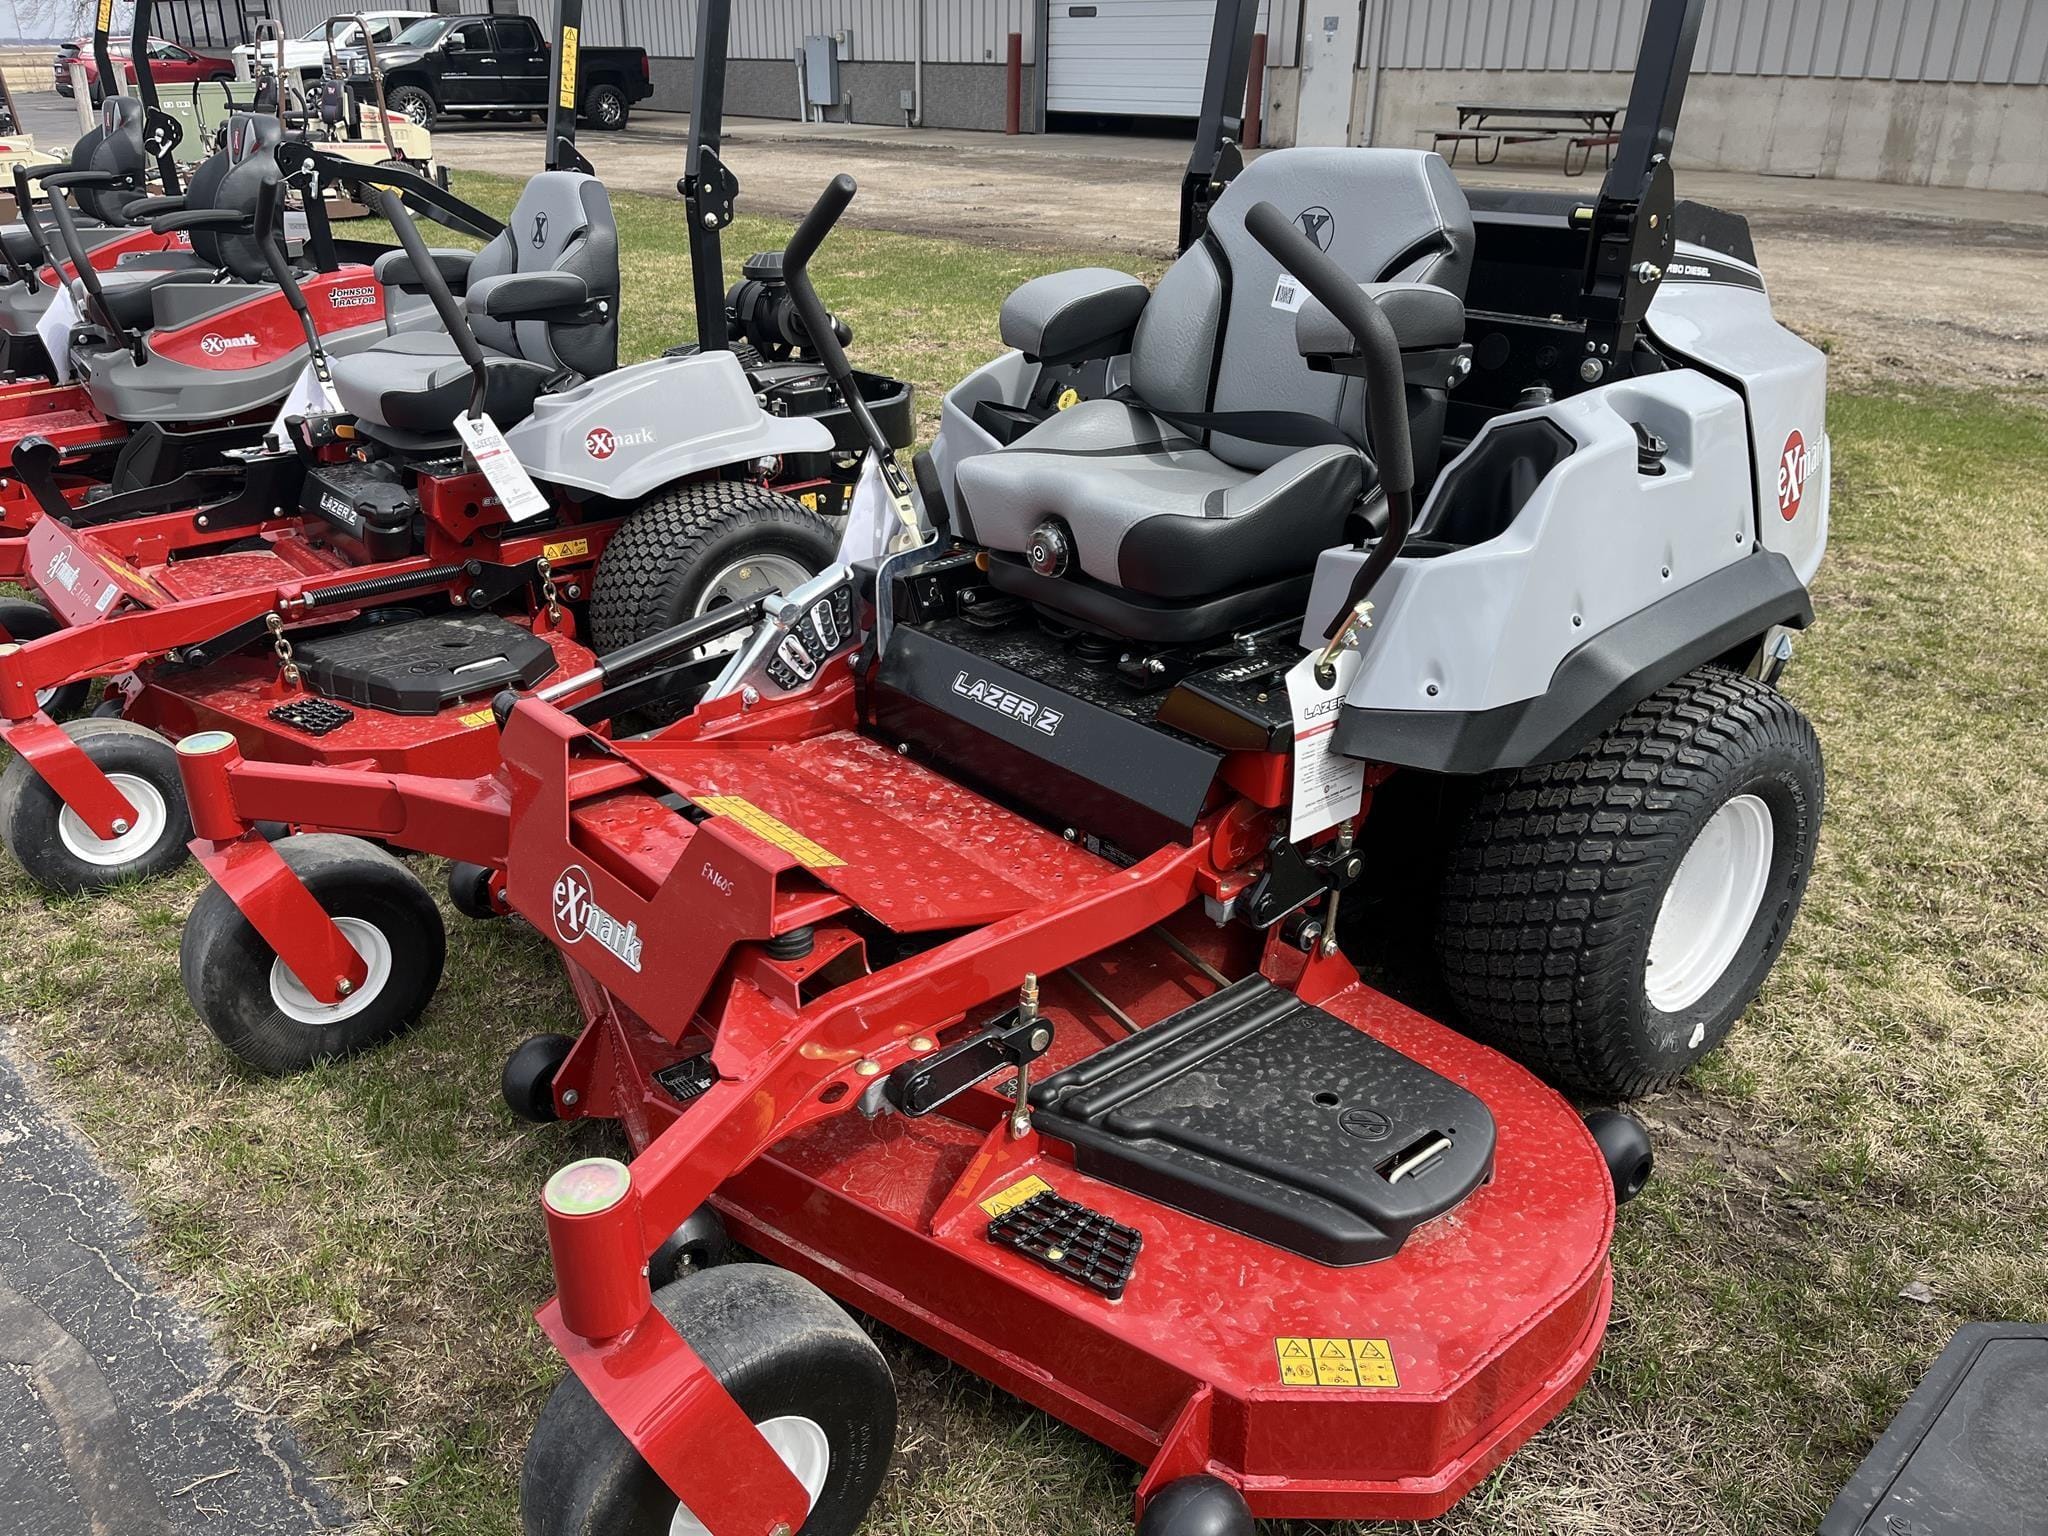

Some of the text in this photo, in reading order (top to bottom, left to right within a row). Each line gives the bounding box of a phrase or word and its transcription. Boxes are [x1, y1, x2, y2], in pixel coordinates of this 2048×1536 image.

[1684, 265, 1711, 278] DIESEL
[328, 286, 375, 298] JOHNSON
[331, 296, 376, 308] TRACTOR
[201, 333, 259, 354] eXmark
[585, 427, 656, 458] eXmark
[320, 492, 349, 521] LAZER
[952, 671, 1064, 736] LAZER Z
[1304, 694, 1347, 720] LAZER
[553, 868, 643, 971] eXmark
